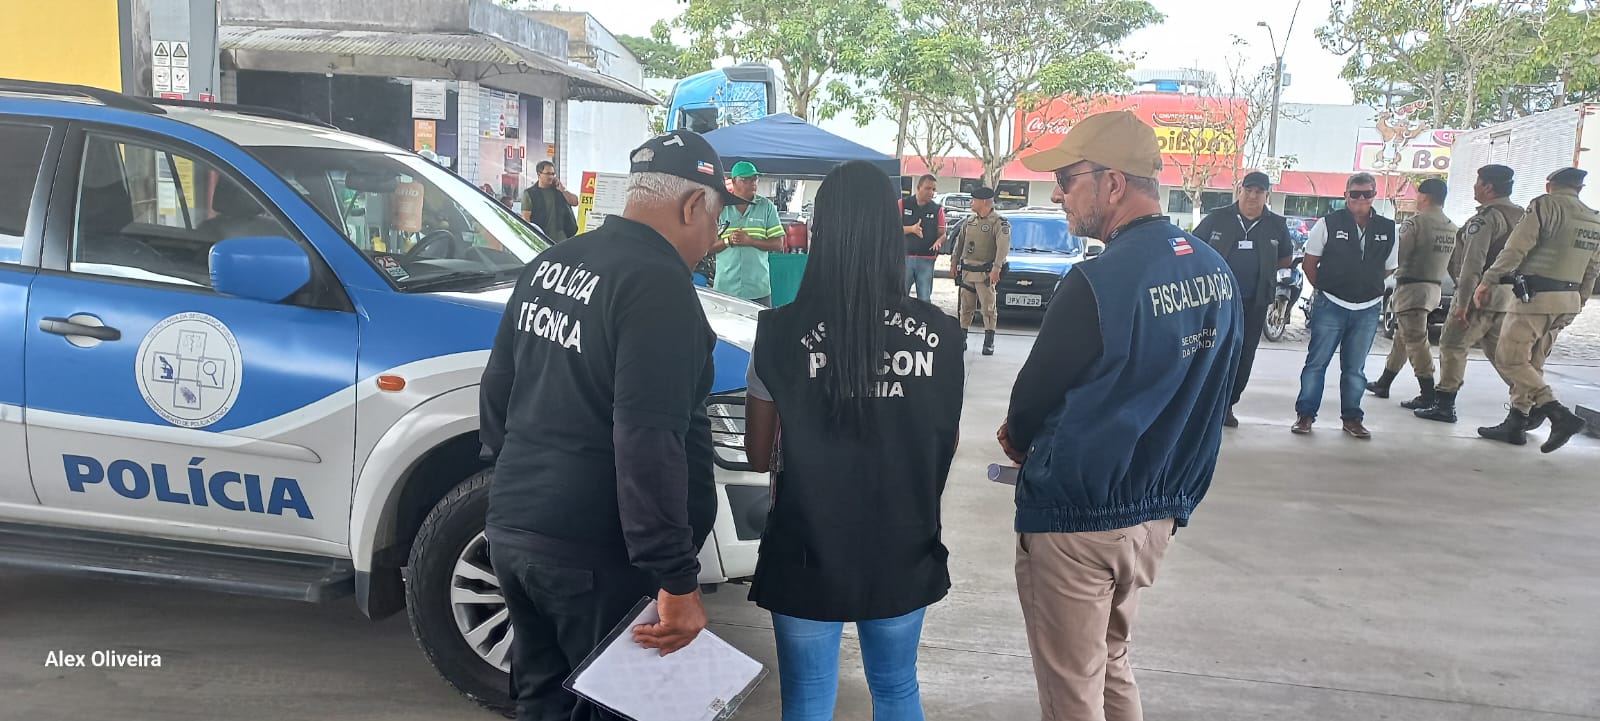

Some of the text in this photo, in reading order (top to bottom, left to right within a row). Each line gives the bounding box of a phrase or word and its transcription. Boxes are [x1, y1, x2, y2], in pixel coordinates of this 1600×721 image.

[530, 260, 600, 305] POLÍCIA
[1149, 266, 1233, 317] FISCALIZAÇÃO
[62, 453, 315, 520] POLÍCIA
